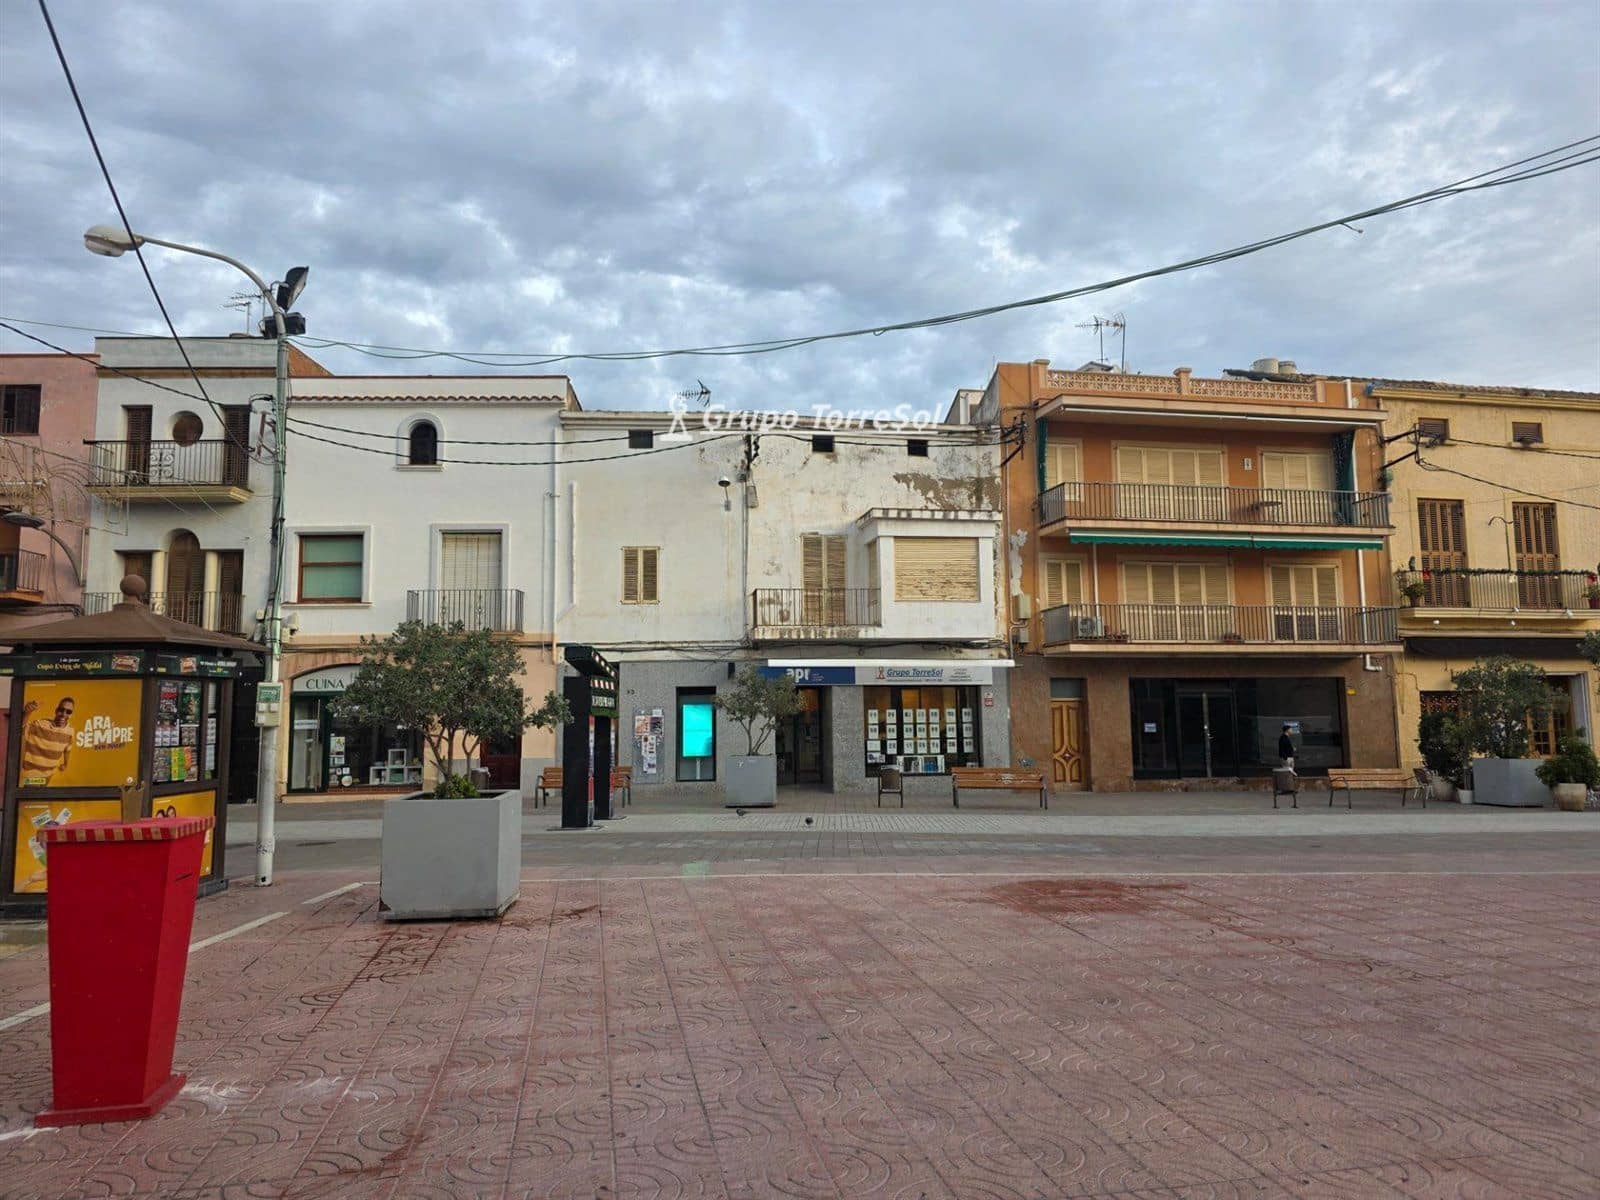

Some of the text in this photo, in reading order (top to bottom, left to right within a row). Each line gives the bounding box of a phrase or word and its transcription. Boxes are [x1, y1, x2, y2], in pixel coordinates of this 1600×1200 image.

[886, 668, 910, 678] Grupo
[912, 668, 944, 678] TorreSol
[306, 678, 344, 689] CUINA
[84, 716, 111, 733] ARA
[76, 727, 134, 748] SEMPRE
